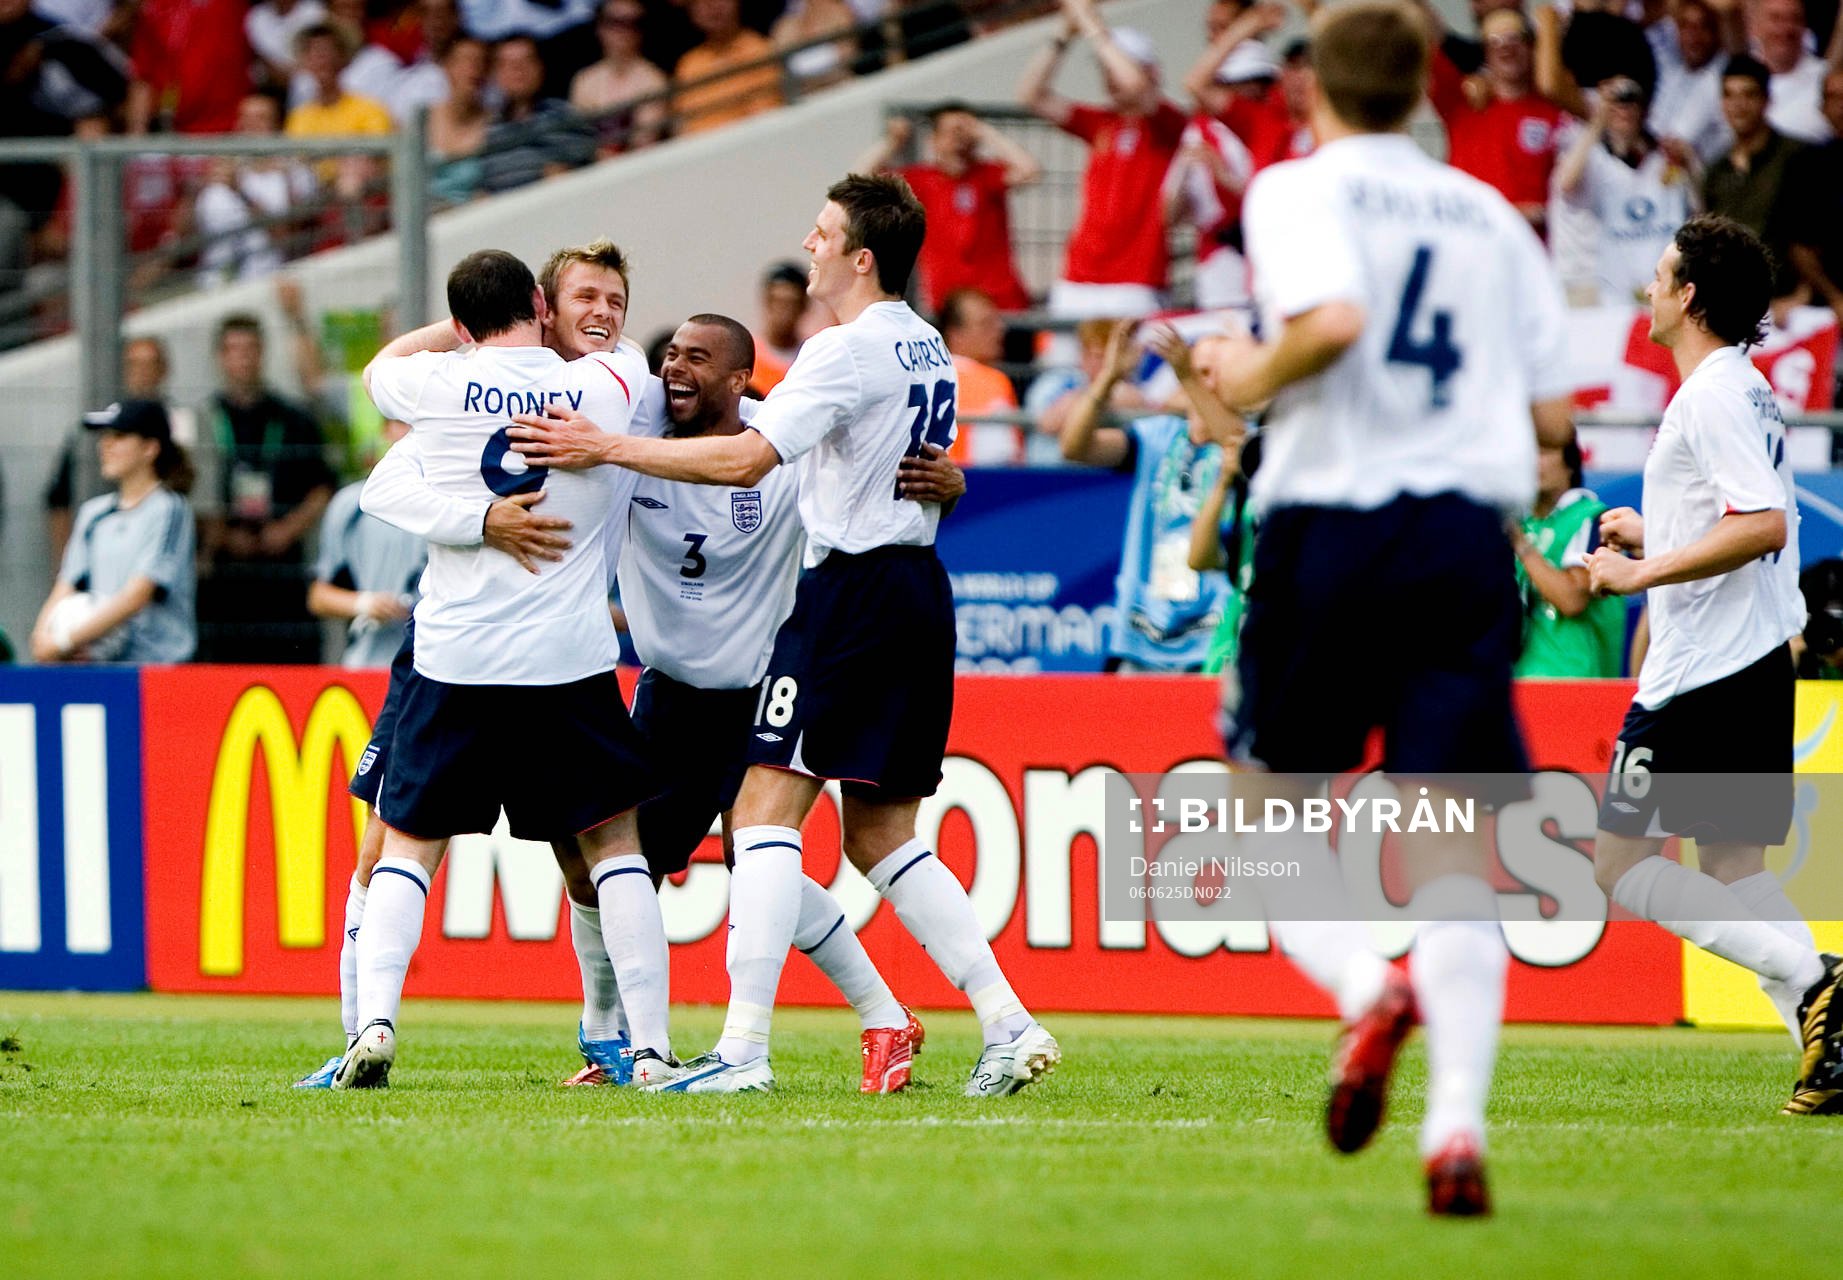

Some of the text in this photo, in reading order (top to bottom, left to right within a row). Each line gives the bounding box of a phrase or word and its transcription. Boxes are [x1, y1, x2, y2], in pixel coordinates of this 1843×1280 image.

[1386, 245, 1460, 408] 4
[680, 533, 708, 579] 3
[956, 603, 1121, 656] ERMAN
[754, 675, 798, 728] 18
[1609, 739, 1654, 799] 16
